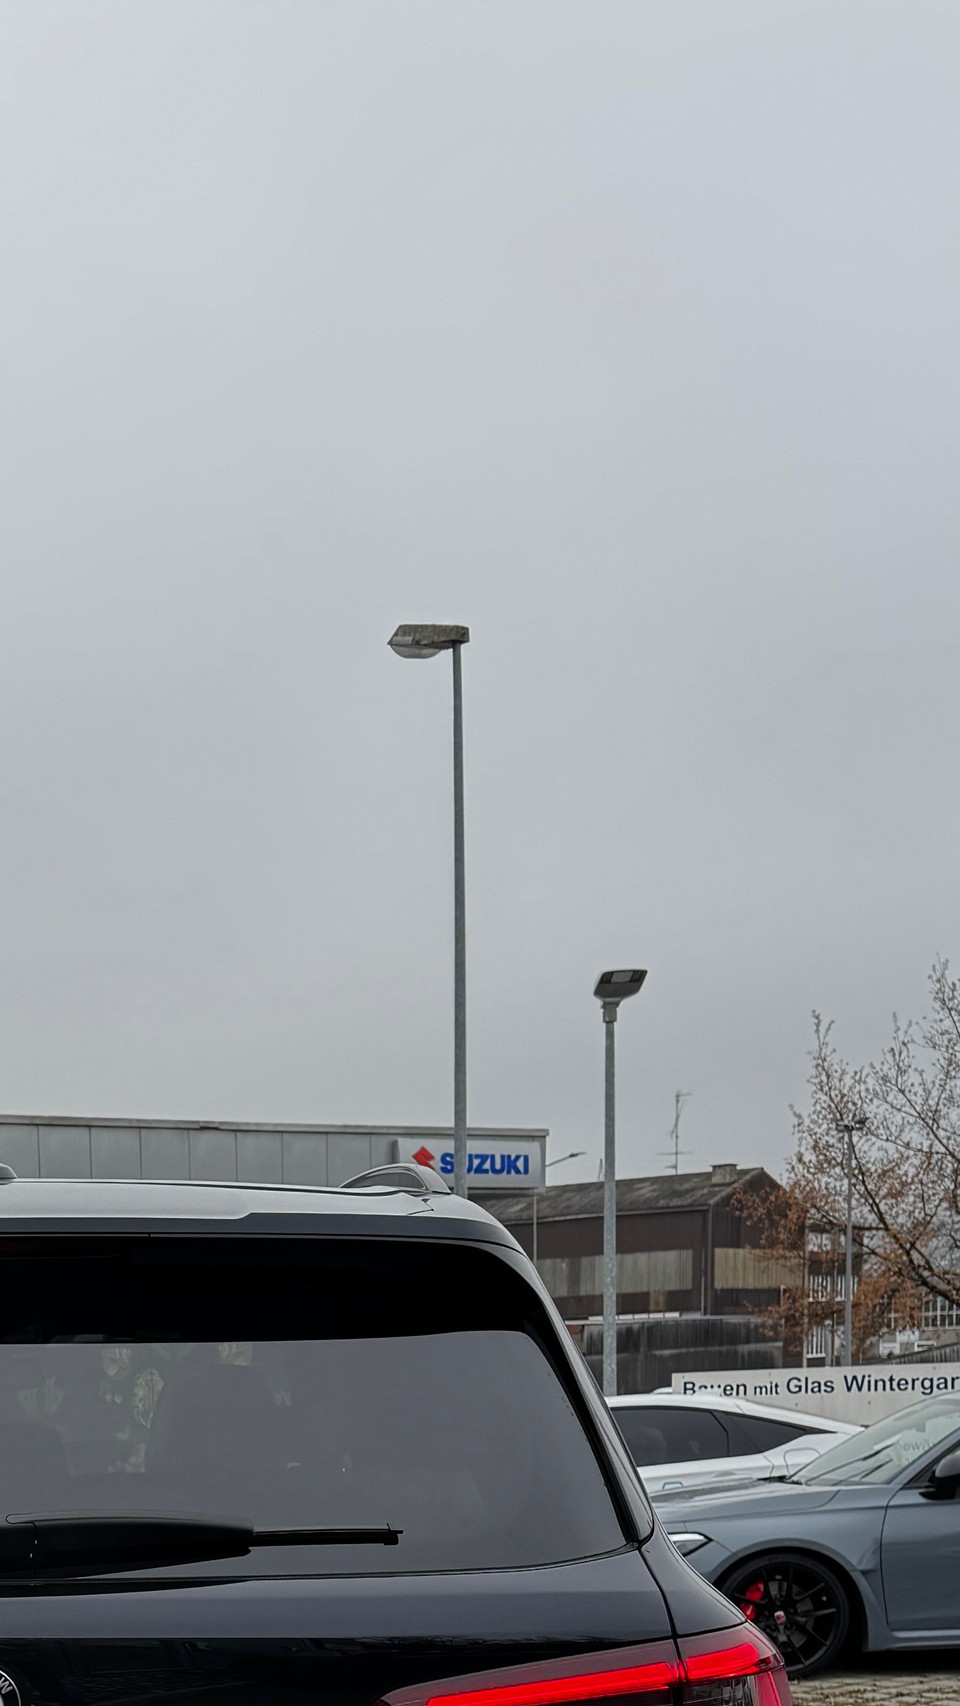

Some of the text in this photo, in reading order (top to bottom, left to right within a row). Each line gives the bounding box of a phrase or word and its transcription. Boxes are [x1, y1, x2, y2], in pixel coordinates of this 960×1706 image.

[682, 1381, 747, 1397] Ben
[753, 1381, 780, 1396] mit
[786, 1376, 835, 1394] Glas
